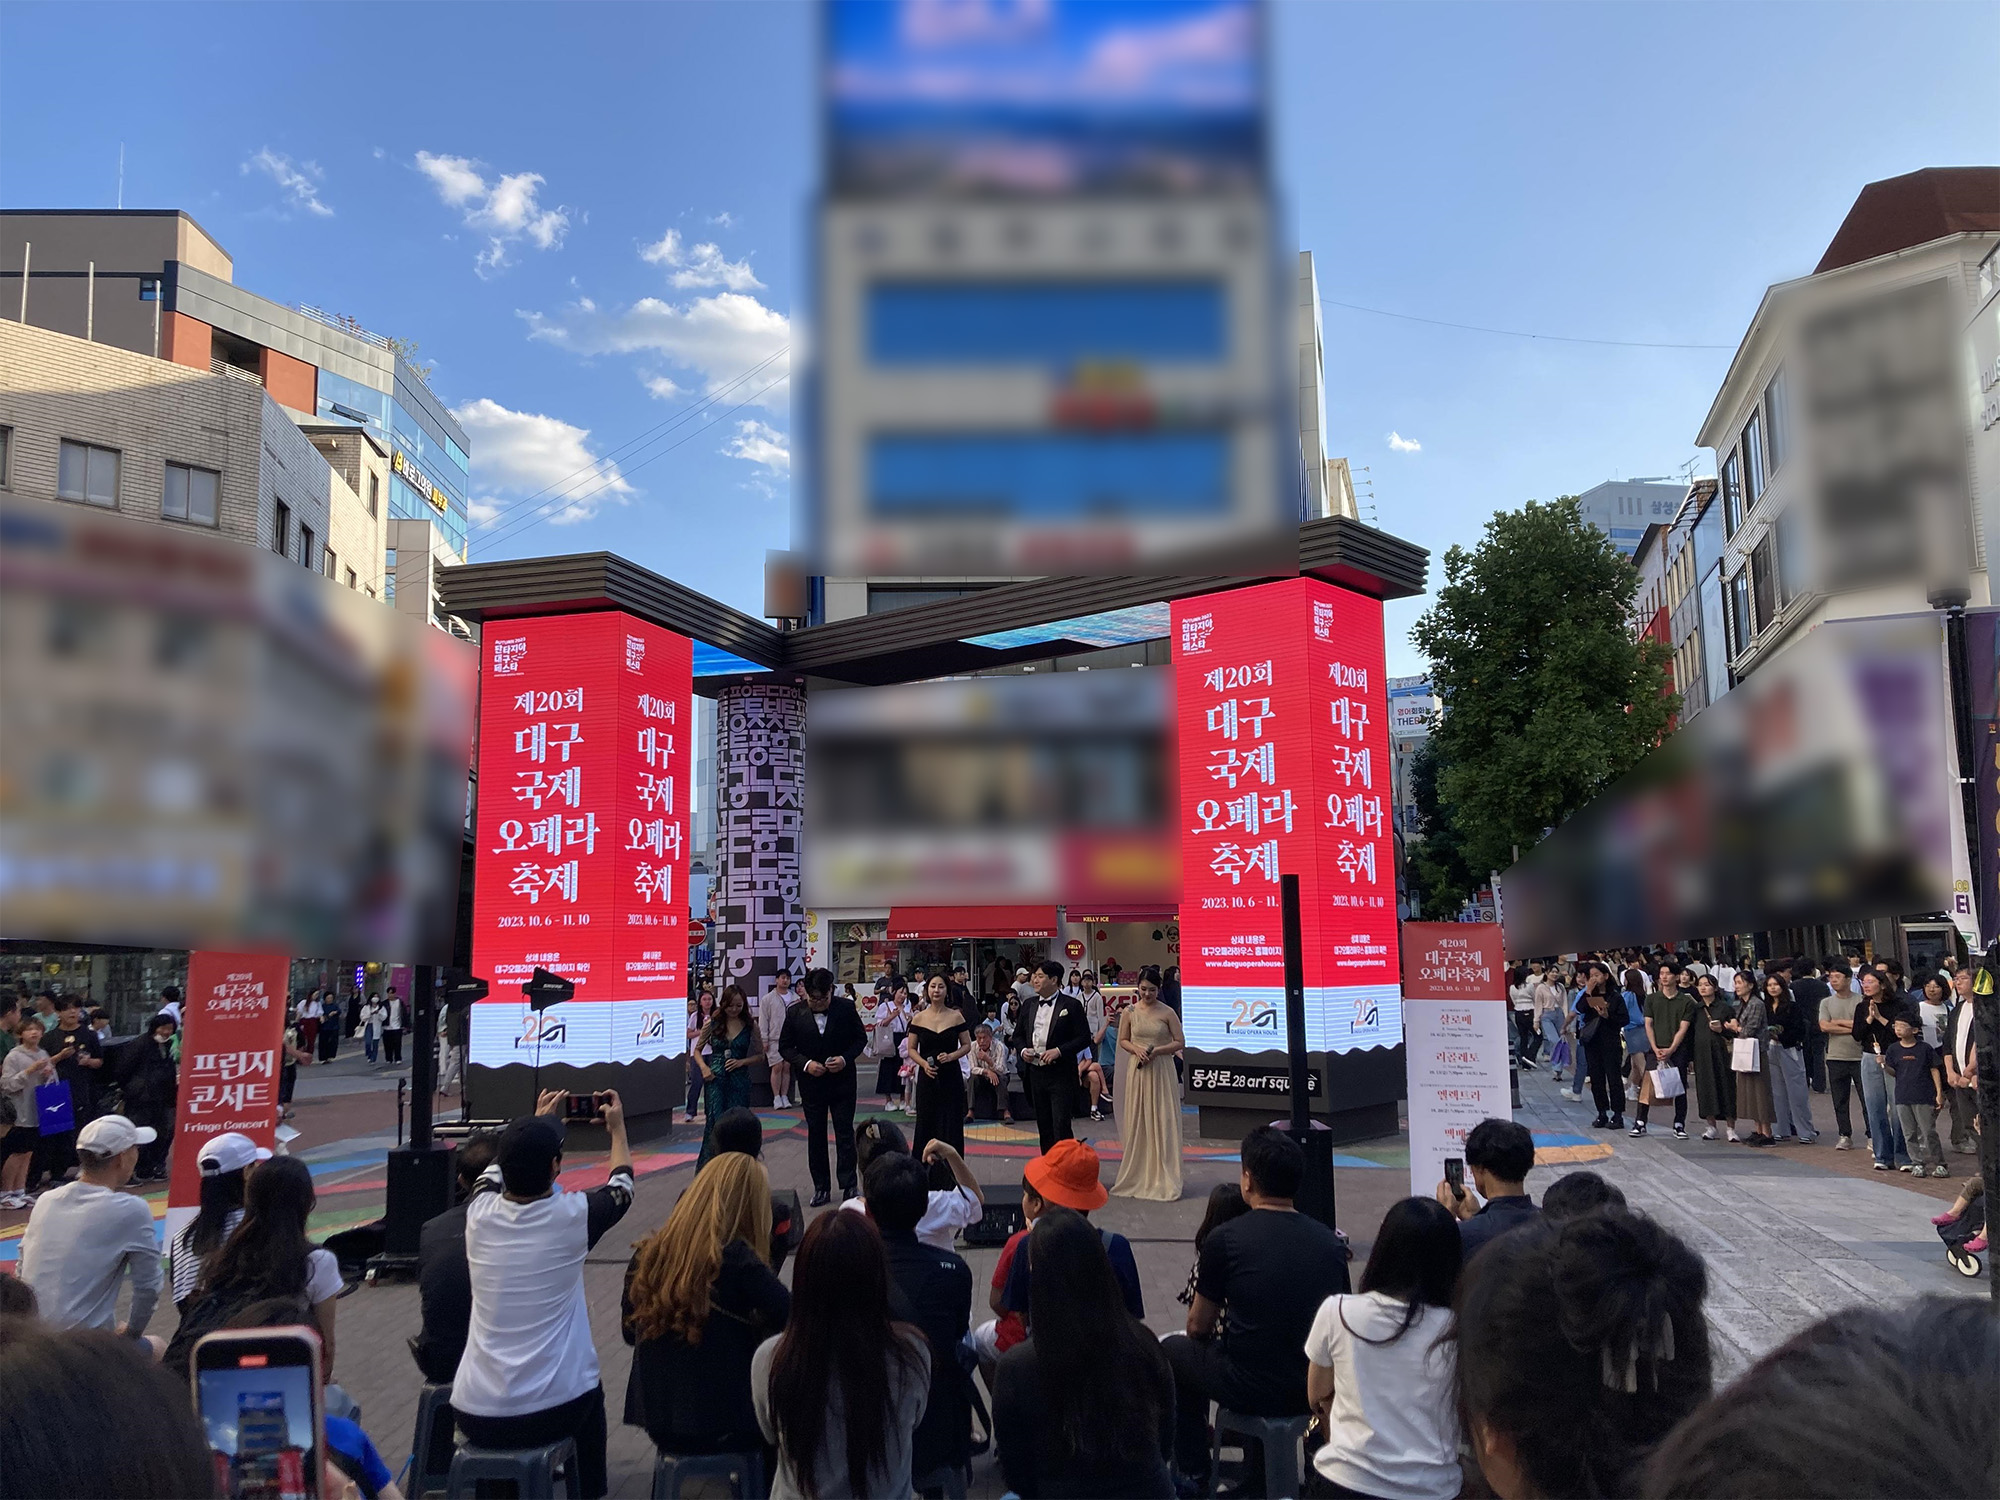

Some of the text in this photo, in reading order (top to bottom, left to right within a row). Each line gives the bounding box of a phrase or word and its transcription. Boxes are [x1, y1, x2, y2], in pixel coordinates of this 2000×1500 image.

[1204, 660, 1272, 692] 제20회
[1328, 662, 1368, 694] 제20회
[513, 687, 584, 716] 제20회
[638, 693, 675, 724] 제20회
[1206, 697, 1276, 740] 대구
[1330, 696, 1370, 741] 대구
[514, 722, 584, 764] 대구
[637, 727, 675, 770] 대구
[1206, 742, 1276, 789] 국제
[1332, 744, 1372, 790] 국제
[512, 766, 581, 810] 국제
[636, 772, 674, 815] 국제
[1191, 790, 1298, 835] 오페라
[1324, 793, 1384, 838] 오페라
[492, 812, 601, 856] 오페라
[625, 818, 683, 860] 오페라
[1209, 840, 1279, 885] 축제
[1336, 840, 1376, 885] 축제
[508, 860, 578, 904] 축제
[634, 861, 672, 904] 축제
[1202, 897, 1229, 908] 2023.
[1232, 896, 1246, 908] 10.
[1248, 896, 1255, 907] 6
[498, 917, 526, 928] 2023.
[544, 916, 552, 926] 6
[578, 914, 590, 925] 10
[1202, 946, 1282, 956] 대구오페라하우스 홈페이지
[1231, 936, 1266, 944] 상세 내용은
[1438, 939, 1468, 948] 제20회
[1205, 960, 1285, 968] www.daeguoperahouse.
[1425, 950, 1482, 965] 대구국제
[214, 982, 264, 996] 대구국제
[1418, 966, 1490, 982] 오페라축제
[206, 996, 269, 1012] 오페라축제
[189, 1050, 274, 1081] 프린지
[1192, 1070, 1231, 1088] 동성로
[1233, 1075, 1246, 1088] 28
[1247, 1076, 1267, 1089] art
[188, 1082, 271, 1114] 콘서트
[184, 1119, 269, 1133] Fringe Concert
